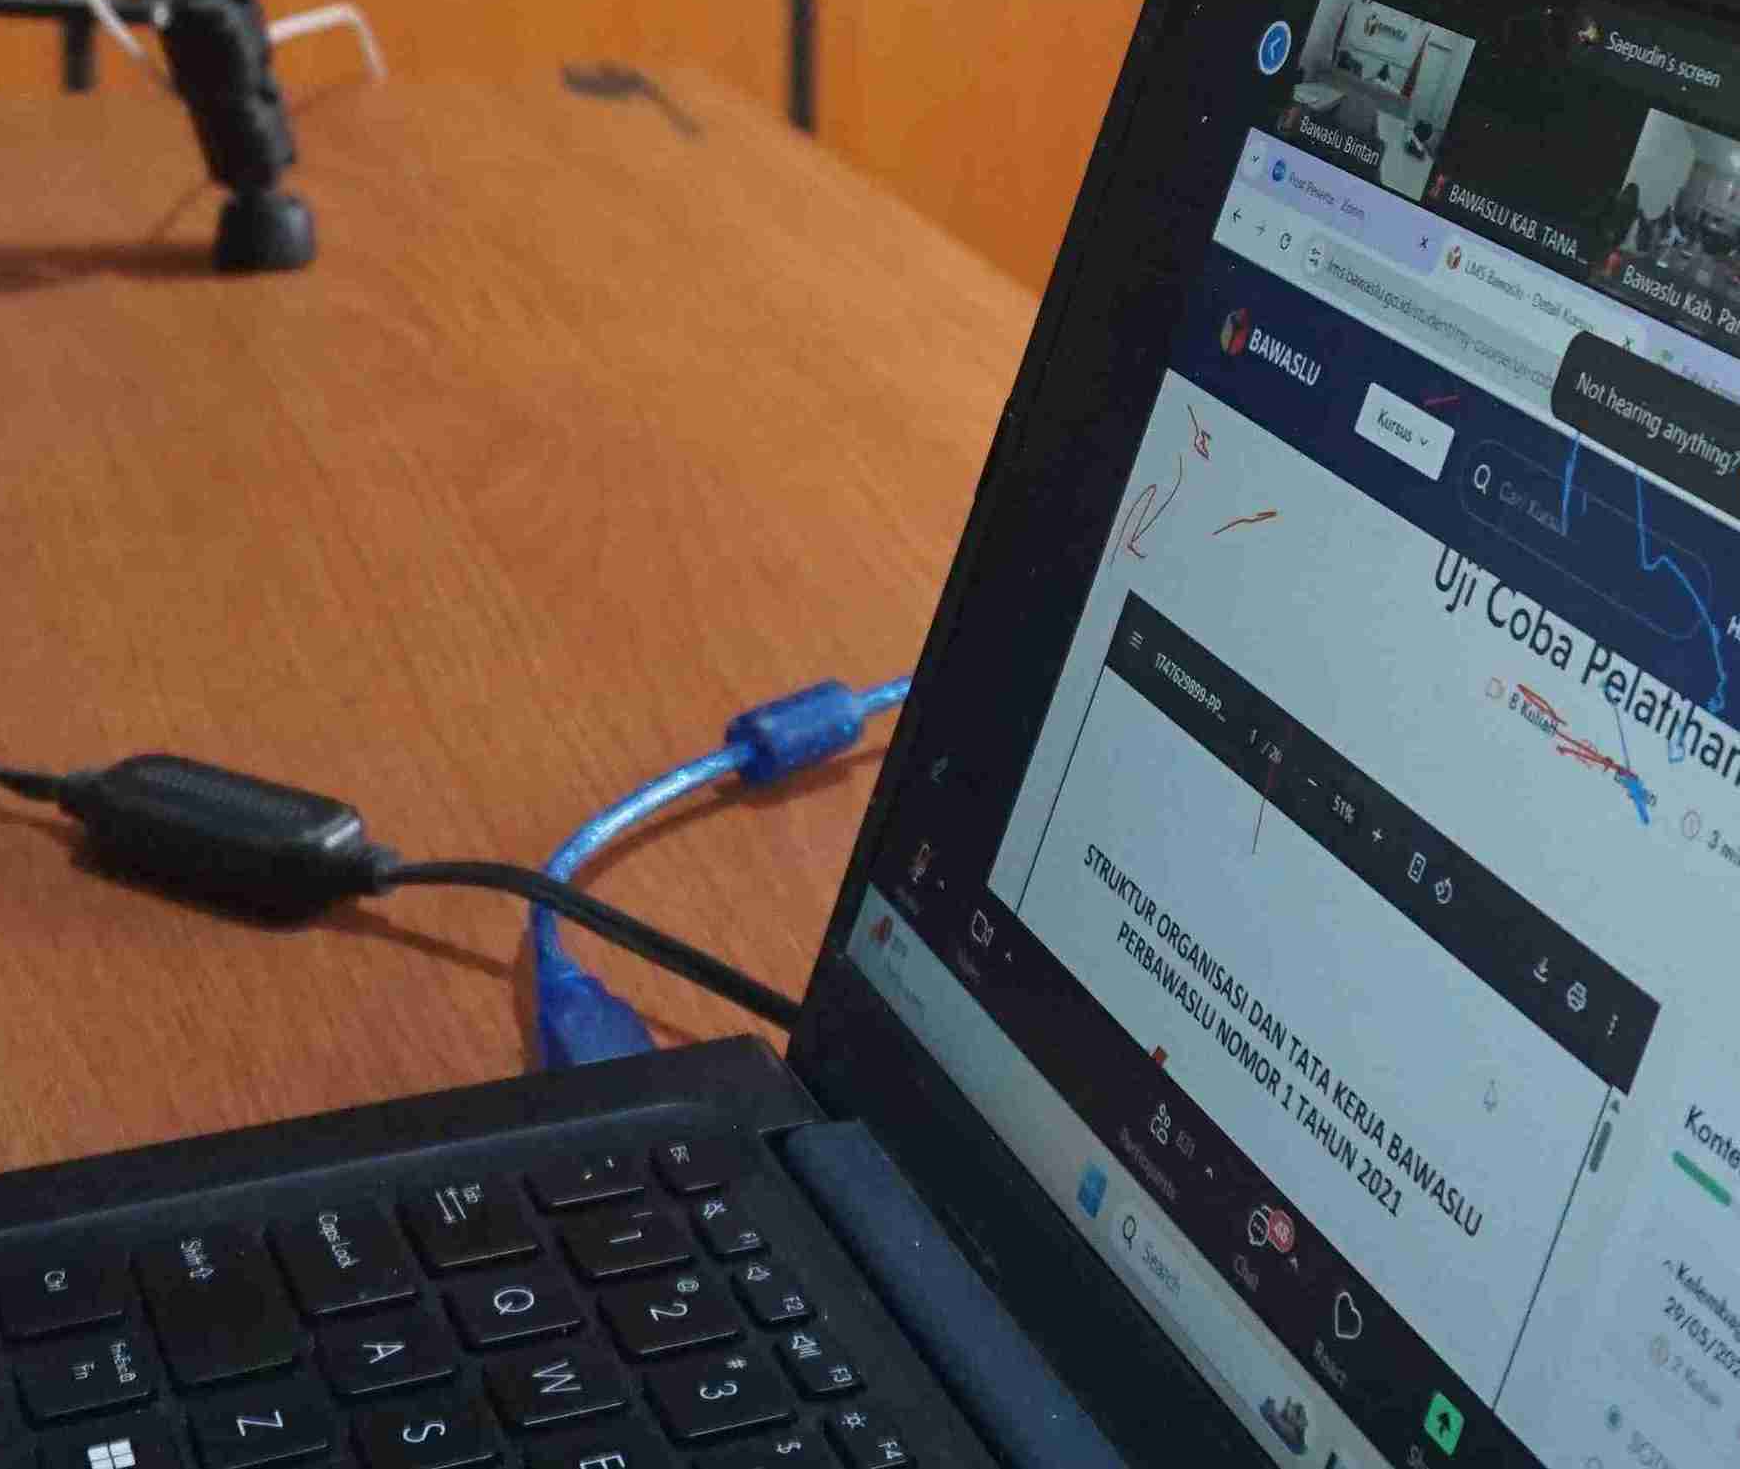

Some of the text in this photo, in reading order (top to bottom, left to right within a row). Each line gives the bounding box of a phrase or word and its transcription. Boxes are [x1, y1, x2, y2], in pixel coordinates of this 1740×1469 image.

[1605, 31, 1722, 88] Saepudin's screen
[1299, 115, 1380, 166] Bawaslu Bintan
[1448, 184, 1510, 226] BAWASLU
[1509, 212, 1539, 242] KAB.
[1622, 264, 1682, 306] Bawaslu
[1681, 292, 1714, 324] Kab.
[1248, 328, 1322, 388] BAWASLU
[1576, 370, 1607, 403] Not
[1605, 384, 1664, 439] hearing
[1376, 407, 1413, 445] Kursus
[1434, 544, 1480, 613] Uji
[1484, 578, 1574, 670] Coba
[1707, 829, 1721, 850] 3
[1083, 843, 1483, 1237] STRUKTUR ORGANISASI DAN TATA KERJA BAWASLU
[1116, 920, 1403, 1218] PERBAWASLU NOMOR 1 TAHUN 2021
[318, 1212, 361, 1269] Caps Lock
[607, 1229, 643, 1245] 1
[493, 1288, 535, 1316] Q
[649, 1301, 690, 1323] 2
[782, 1294, 806, 1314] F2
[363, 1341, 406, 1365] A
[531, 1359, 582, 1395] W
[699, 1381, 740, 1401] 3
[828, 1364, 855, 1386] F3
[235, 1408, 284, 1437] Z
[402, 1418, 446, 1444] S
[877, 1438, 904, 1461] F4
